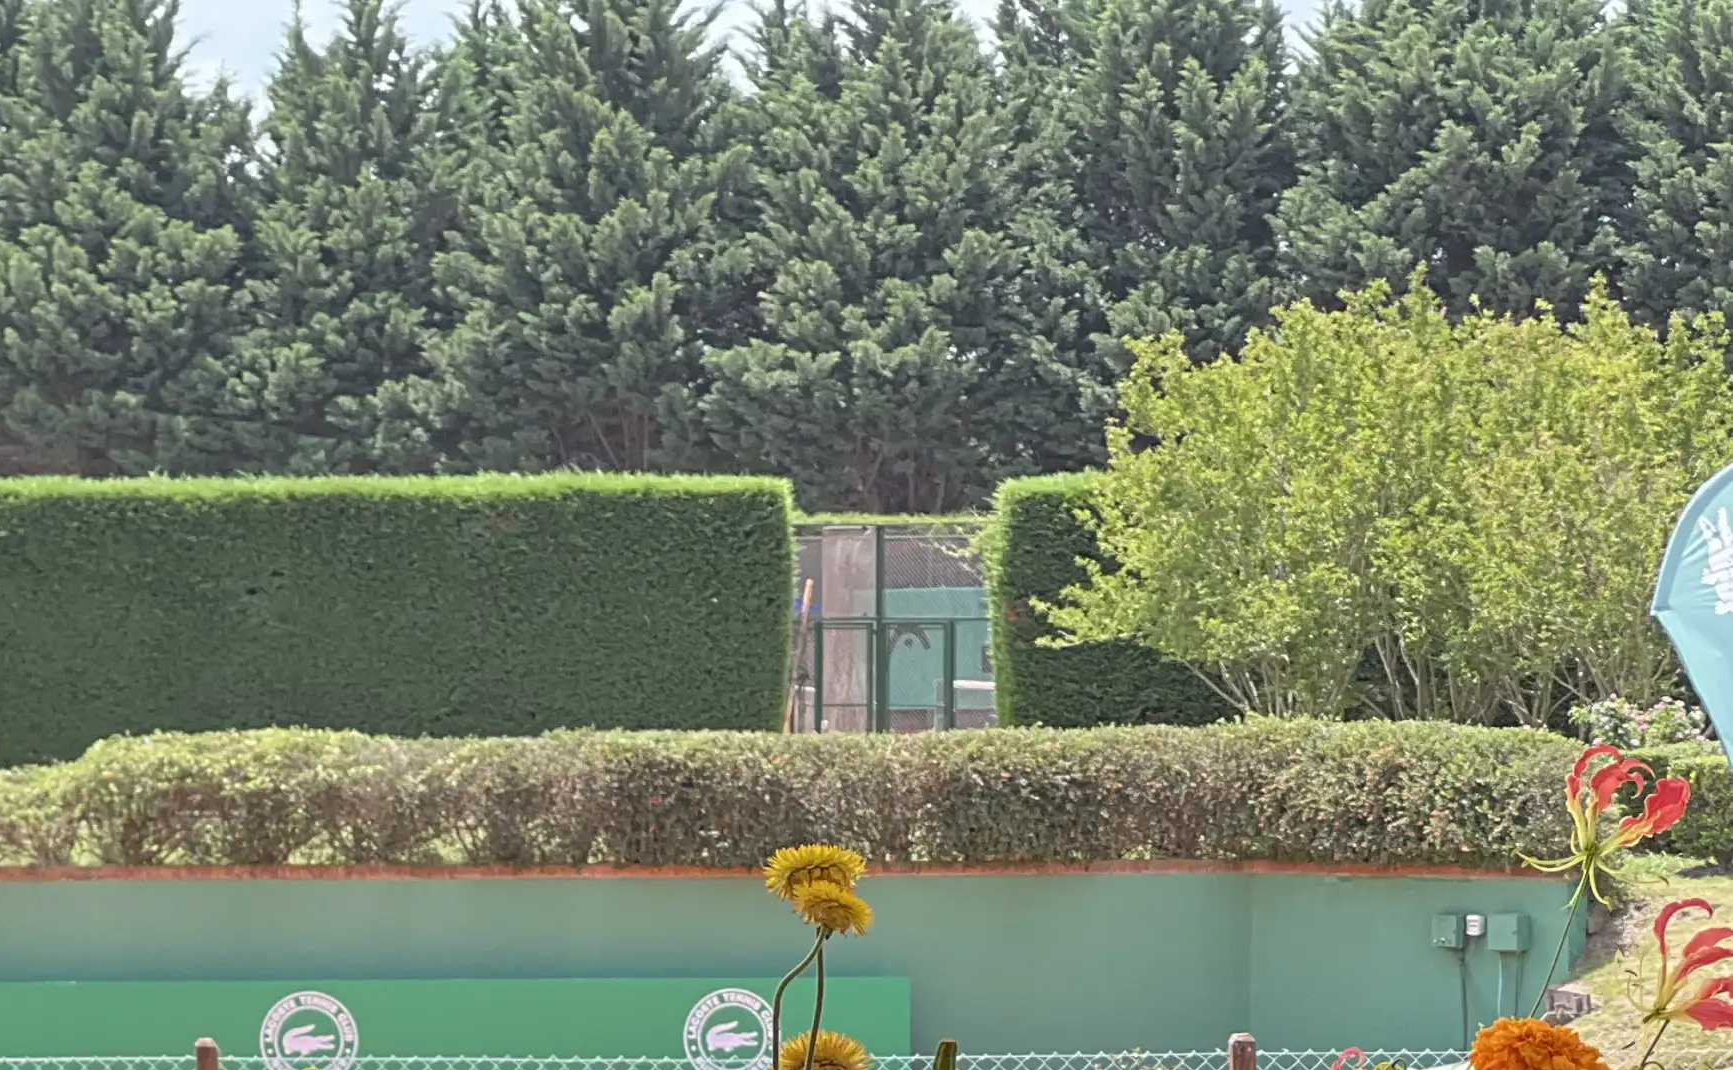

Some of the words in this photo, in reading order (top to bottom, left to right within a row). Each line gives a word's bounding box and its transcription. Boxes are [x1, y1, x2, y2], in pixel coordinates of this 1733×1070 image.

[264, 998, 296, 1041] LACOSTE
[300, 994, 338, 1012] TENNIS
[337, 1010, 355, 1042] CLUB
[688, 996, 720, 1038] LACOSTE
[724, 992, 760, 1009] TENNIS
